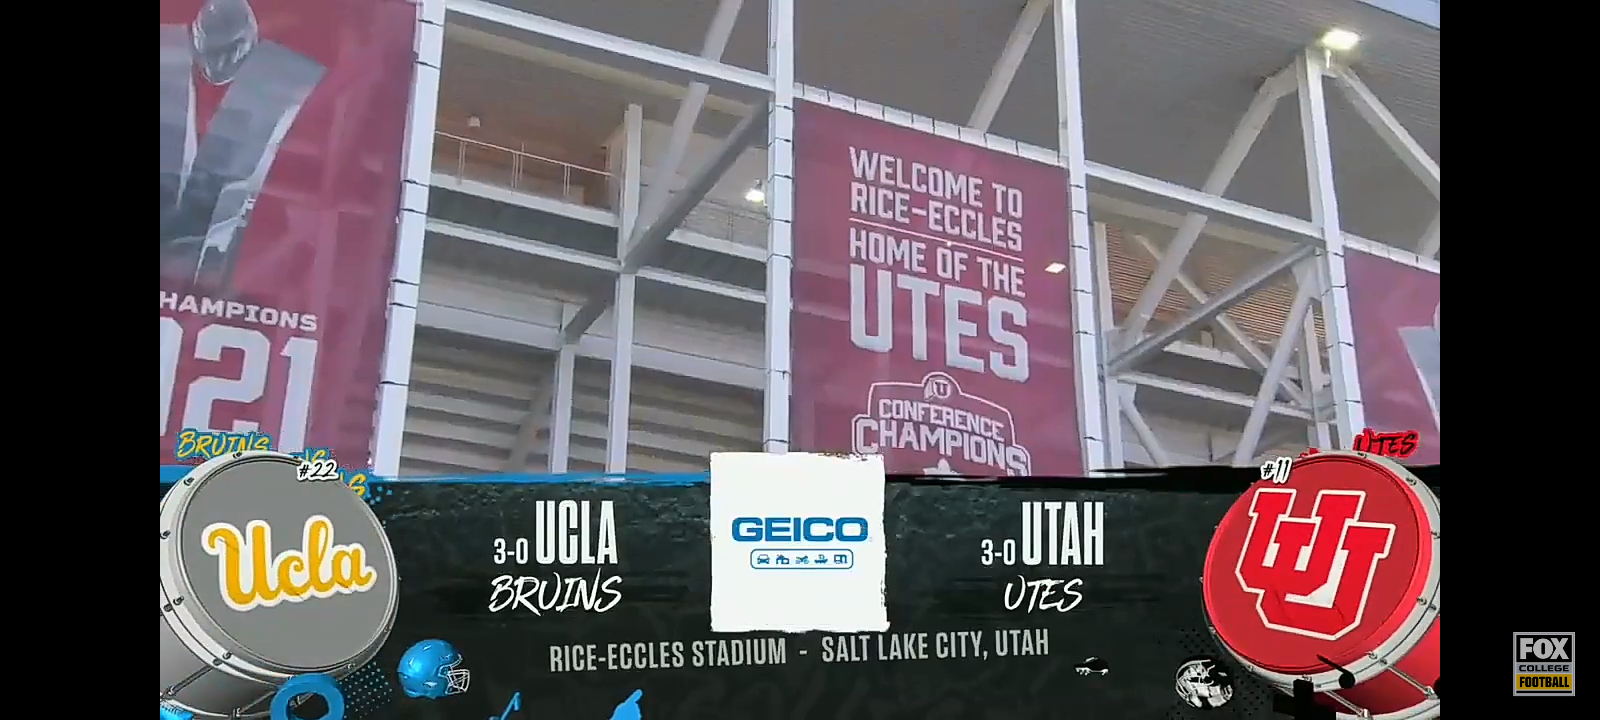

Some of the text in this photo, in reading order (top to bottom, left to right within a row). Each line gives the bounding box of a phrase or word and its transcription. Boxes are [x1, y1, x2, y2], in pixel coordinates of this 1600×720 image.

[849, 146, 1022, 218] WELCOME TO
[850, 181, 1022, 251] RICE-ECCLES
[850, 227, 1026, 298] HOME OF THE
[850, 263, 1030, 382] UTES
[855, 417, 1029, 477] CHAMPIONS
[878, 398, 1005, 442] CONFERENCE
